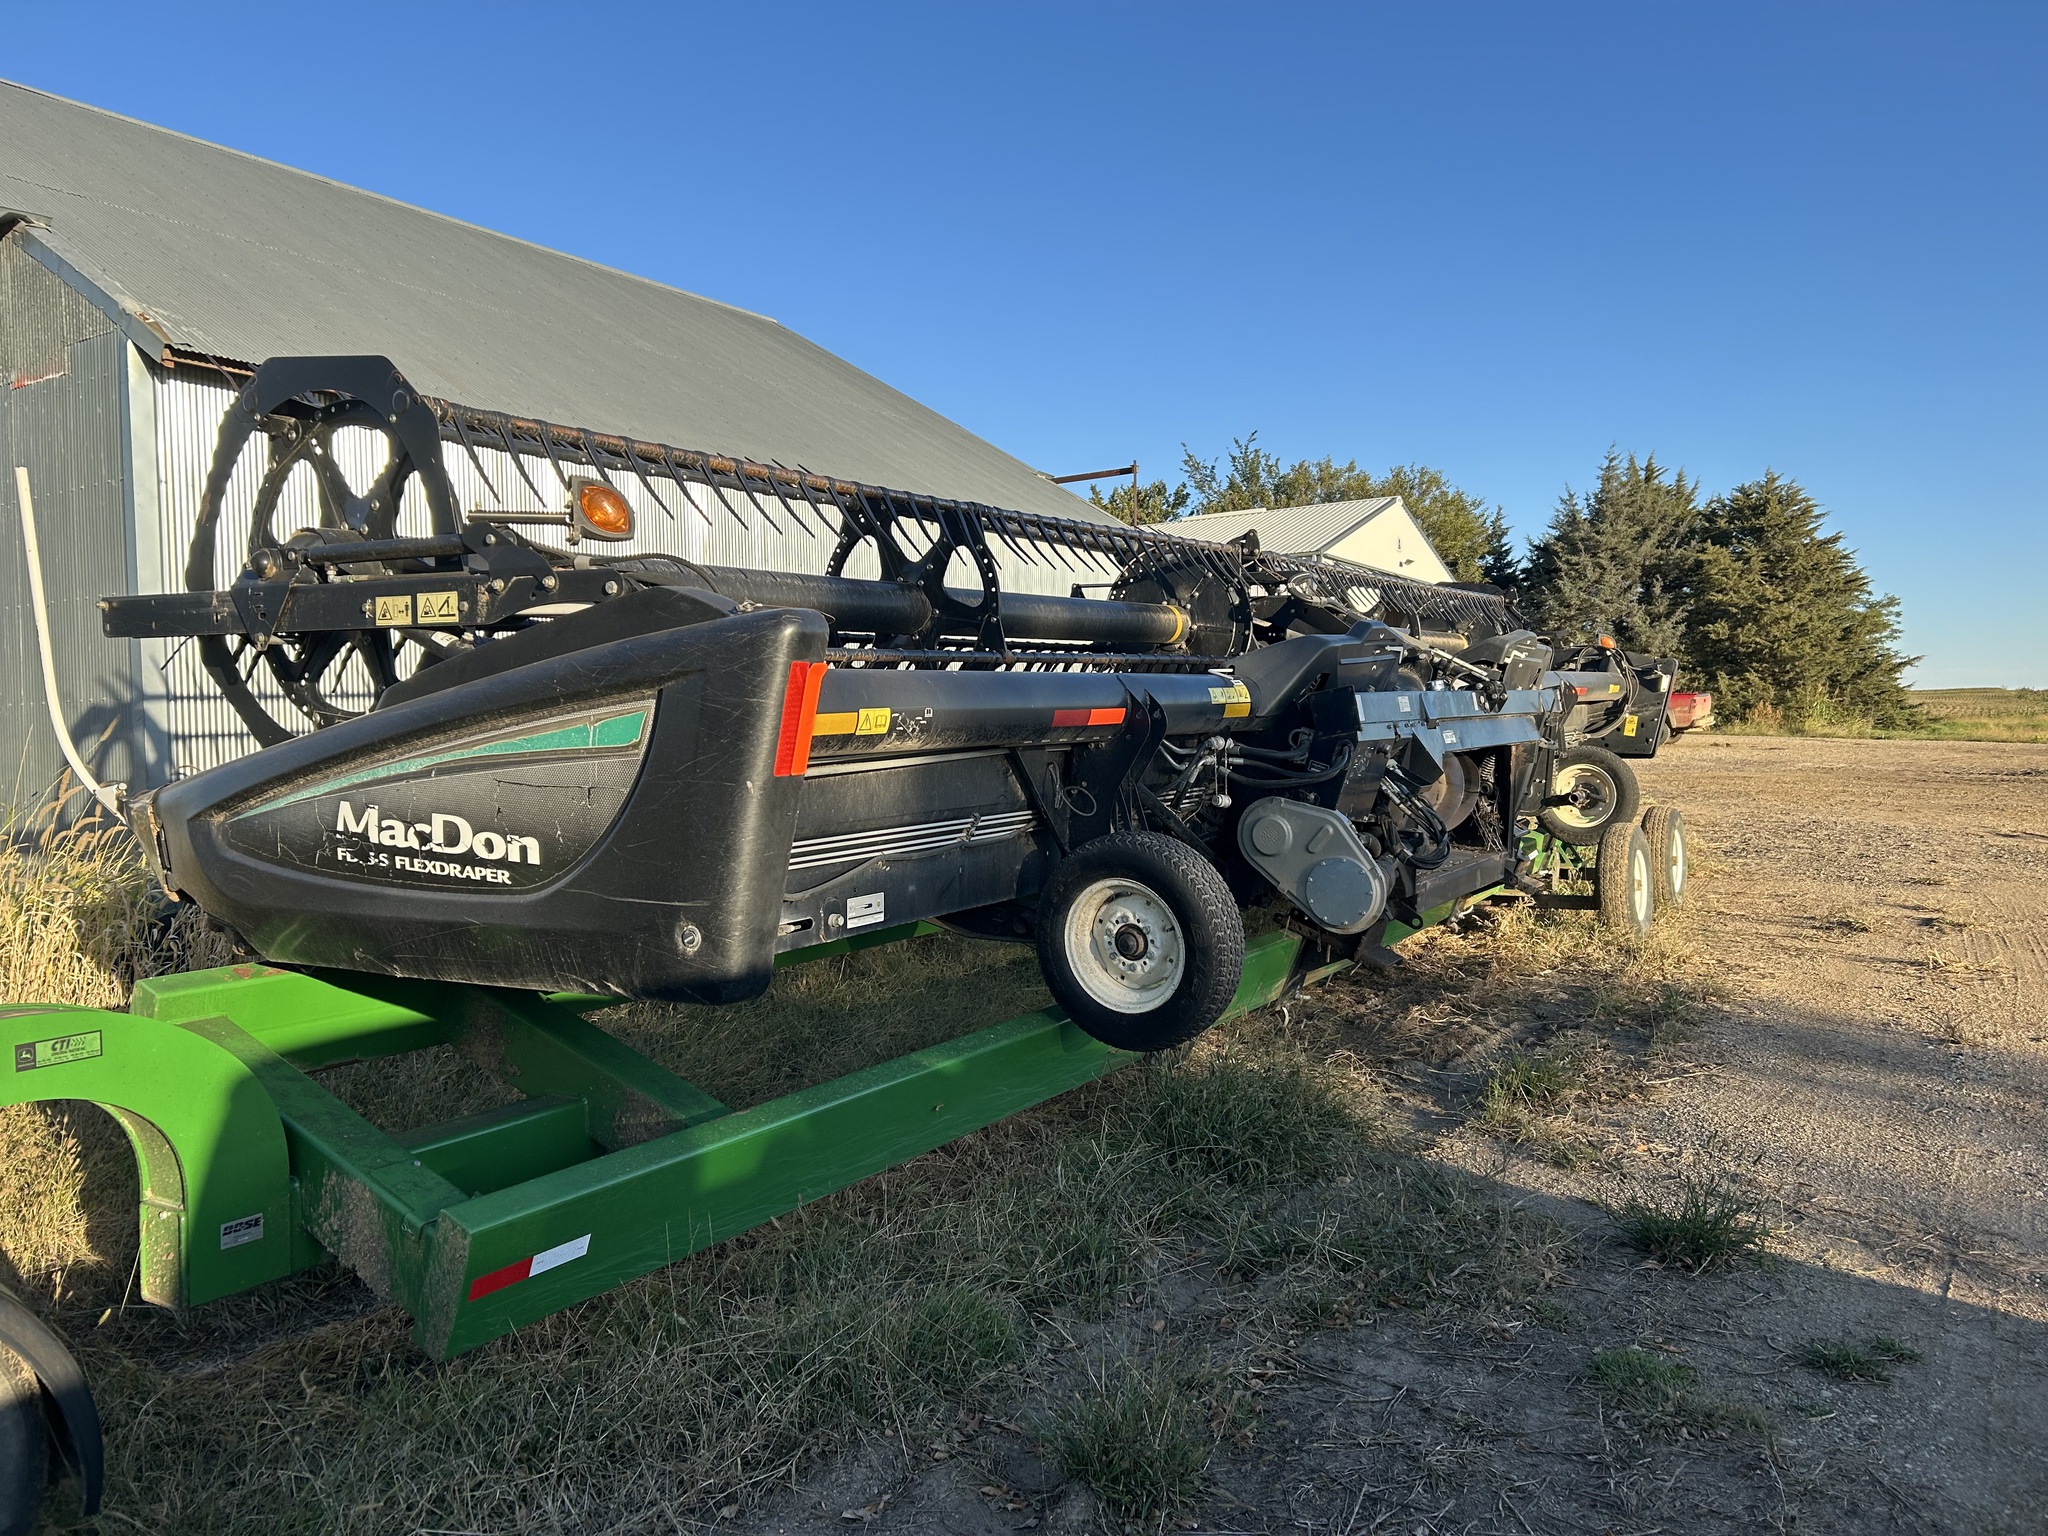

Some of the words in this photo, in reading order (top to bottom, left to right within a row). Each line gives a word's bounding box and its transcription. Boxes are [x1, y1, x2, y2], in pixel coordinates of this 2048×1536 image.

[336, 800, 541, 866] MacDon
[394, 855, 512, 885] FLEXDRAPER
[51, 1038, 71, 1052] CTI
